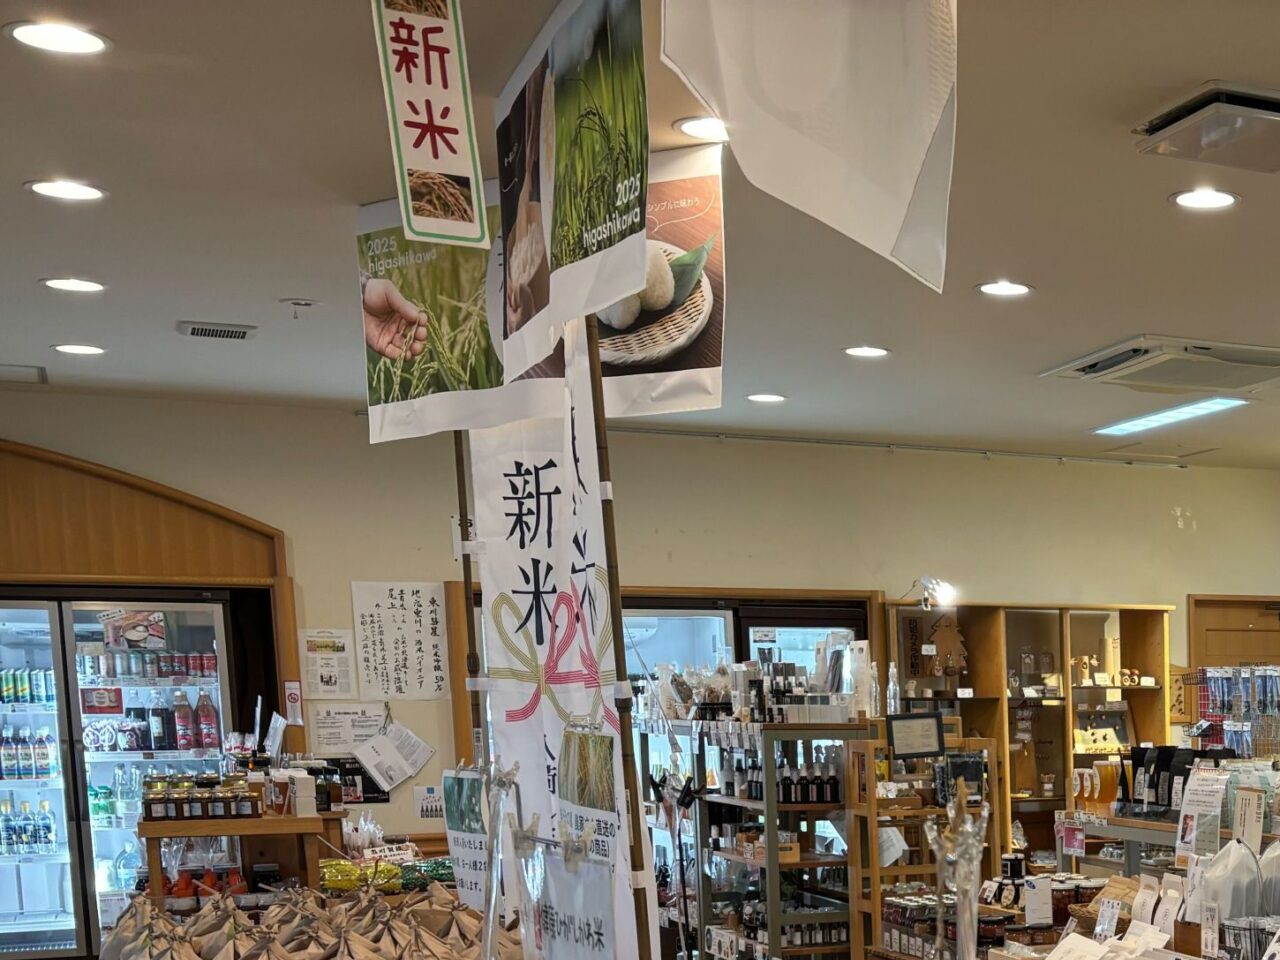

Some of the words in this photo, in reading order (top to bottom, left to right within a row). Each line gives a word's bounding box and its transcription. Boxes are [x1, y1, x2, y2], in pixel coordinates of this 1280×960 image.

[389, 17, 459, 160] 新米
[615, 173, 641, 207] 2025
[368, 236, 398, 257] 2025
[582, 207, 641, 251] higashikawa
[368, 249, 437, 275] higashikawa
[502, 458, 562, 646] 新米
